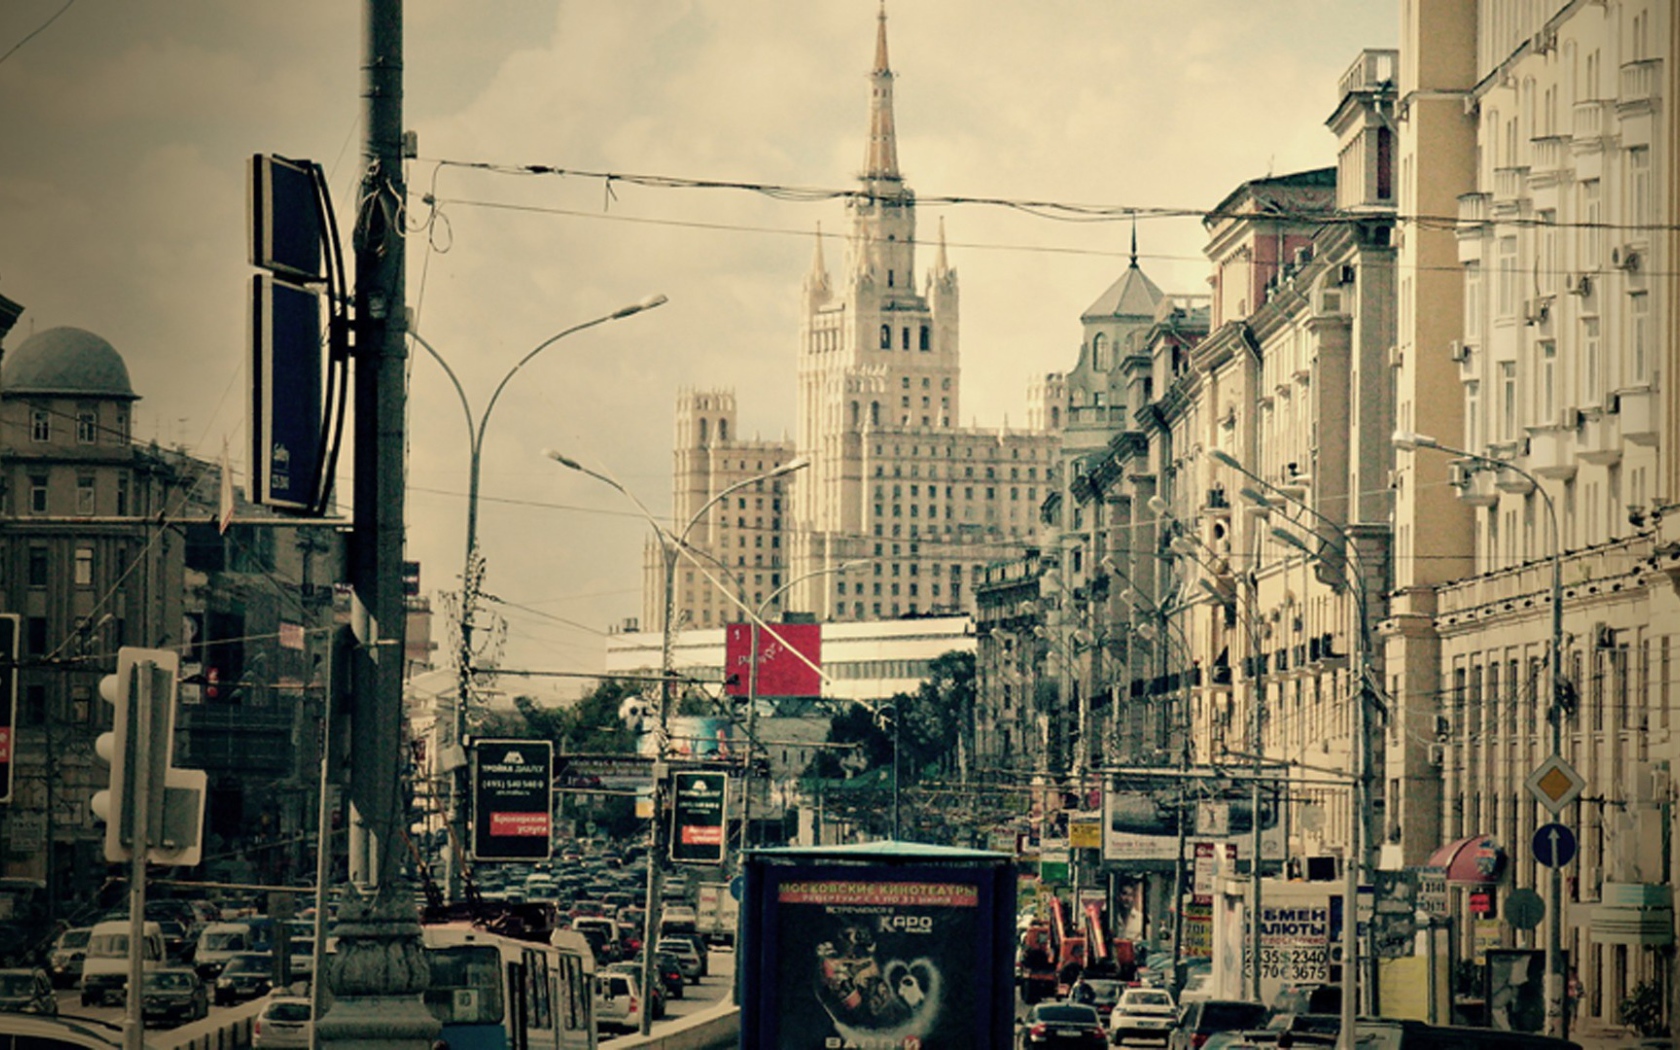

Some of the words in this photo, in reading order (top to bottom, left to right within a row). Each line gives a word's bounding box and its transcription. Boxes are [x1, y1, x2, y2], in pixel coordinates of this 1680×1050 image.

[879, 884, 978, 896] КИНОТЕАТРЫ
[878, 916, 933, 933] КАРО
[1292, 950, 1326, 964] 2340
[1292, 965, 1326, 979] 3675
